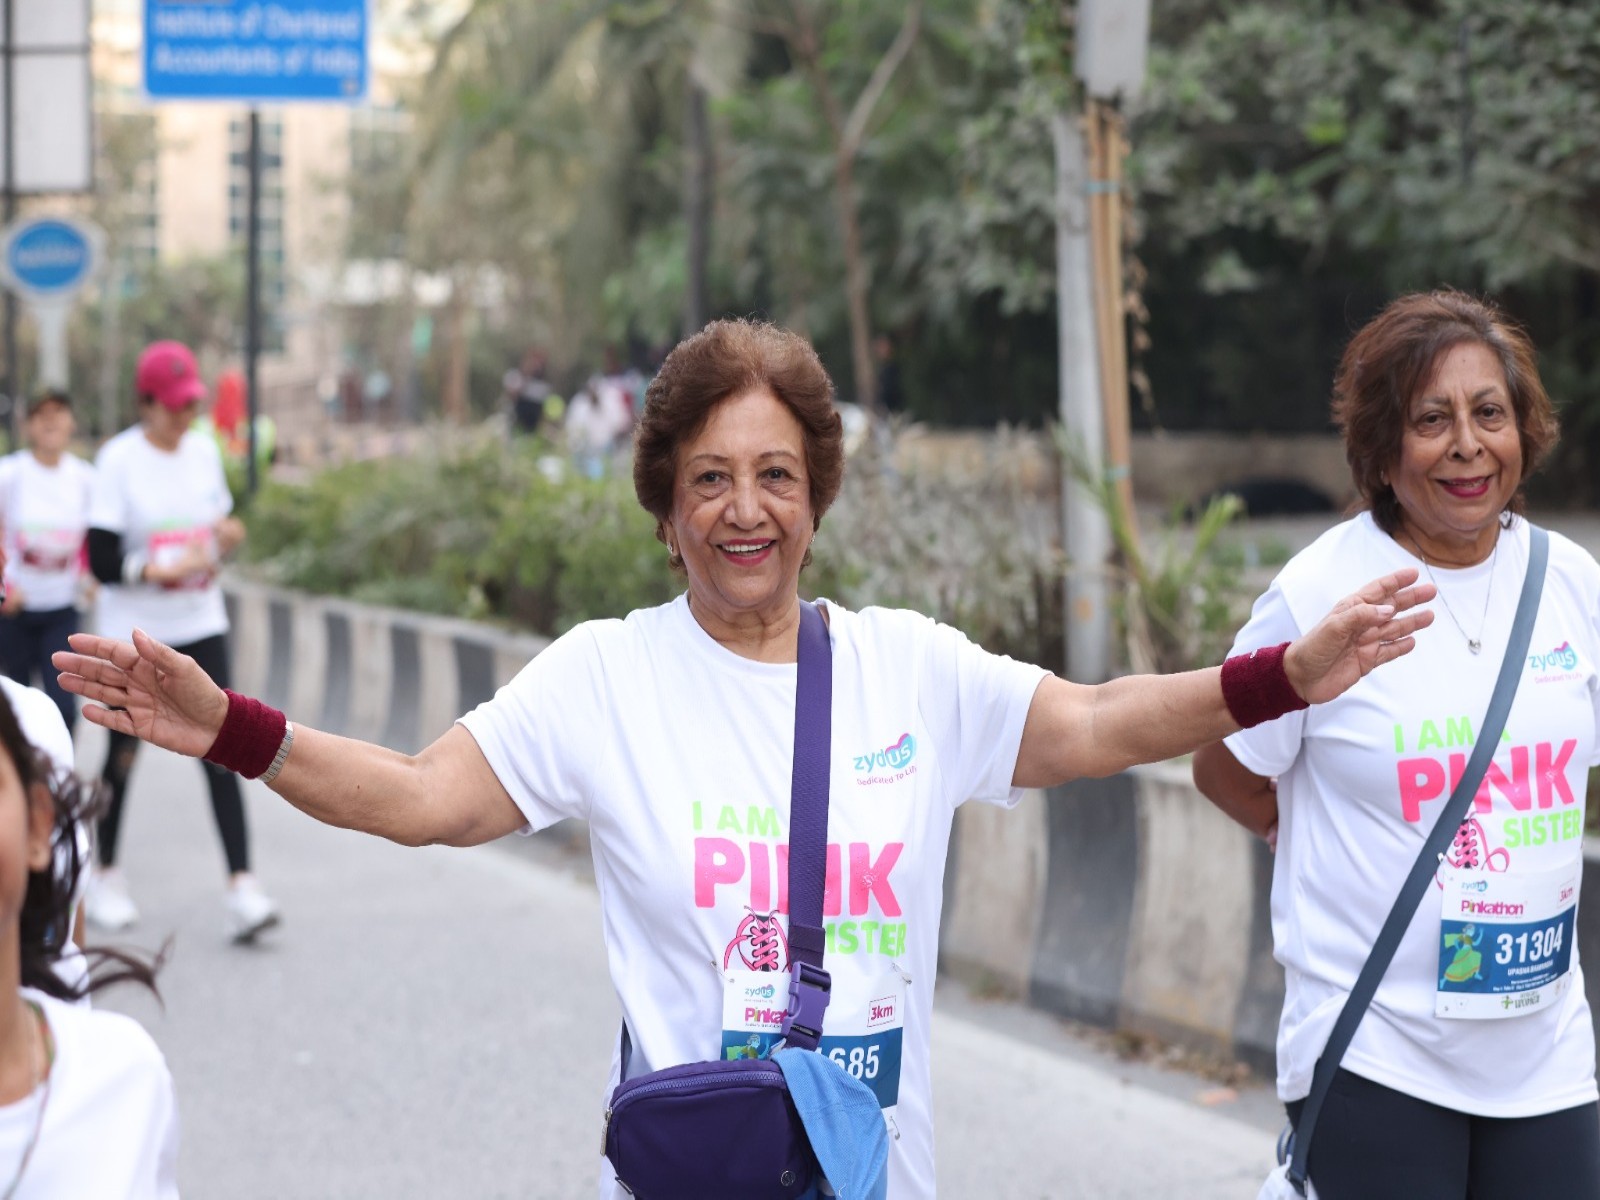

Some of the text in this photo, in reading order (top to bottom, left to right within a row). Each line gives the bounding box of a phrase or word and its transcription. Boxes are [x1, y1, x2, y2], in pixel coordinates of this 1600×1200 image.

[1528, 648, 1577, 671] zydus
[1394, 716, 1475, 753] I AM
[853, 740, 914, 772] zydus
[905, 766, 917, 775] Lif
[1397, 739, 1577, 822] PINK
[692, 801, 781, 837] I AM
[1503, 809, 1581, 848] SISTER
[1461, 899, 1524, 915] Pinkathon
[825, 920, 906, 957] ISTER
[1495, 922, 1564, 964] 31304
[745, 985, 775, 998] zydus
[870, 1004, 893, 1020] 3km
[815, 1045, 880, 1080] 685
